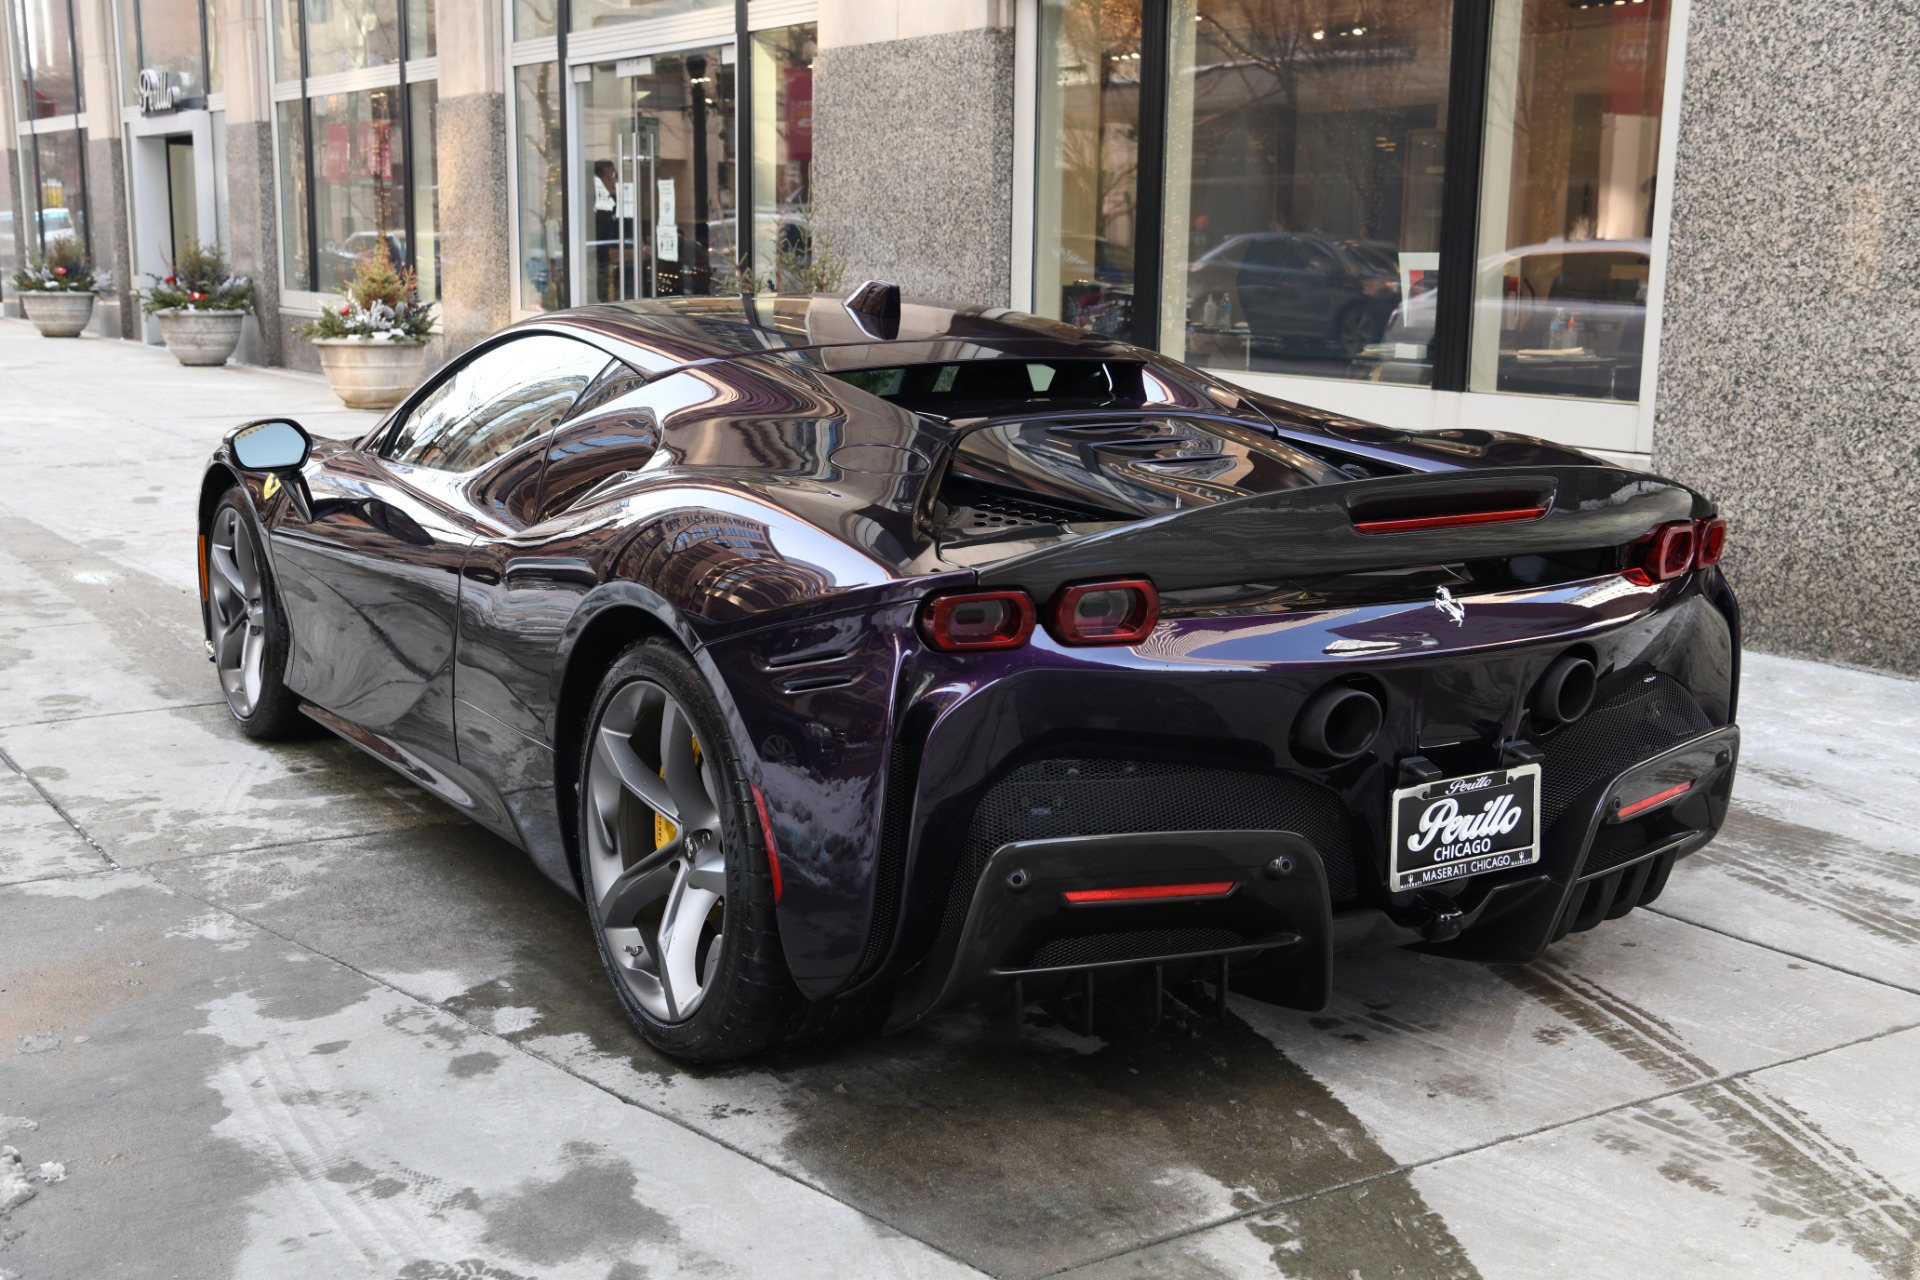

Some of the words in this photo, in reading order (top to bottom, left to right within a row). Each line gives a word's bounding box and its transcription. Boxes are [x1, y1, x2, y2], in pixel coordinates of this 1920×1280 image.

[1445, 776, 1492, 796] Perillo
[1407, 794, 1522, 852] Perillo
[1433, 838, 1491, 862] CHICAGO
[1422, 863, 1467, 883] MASERATI
[1470, 854, 1511, 872] CHICAGO
